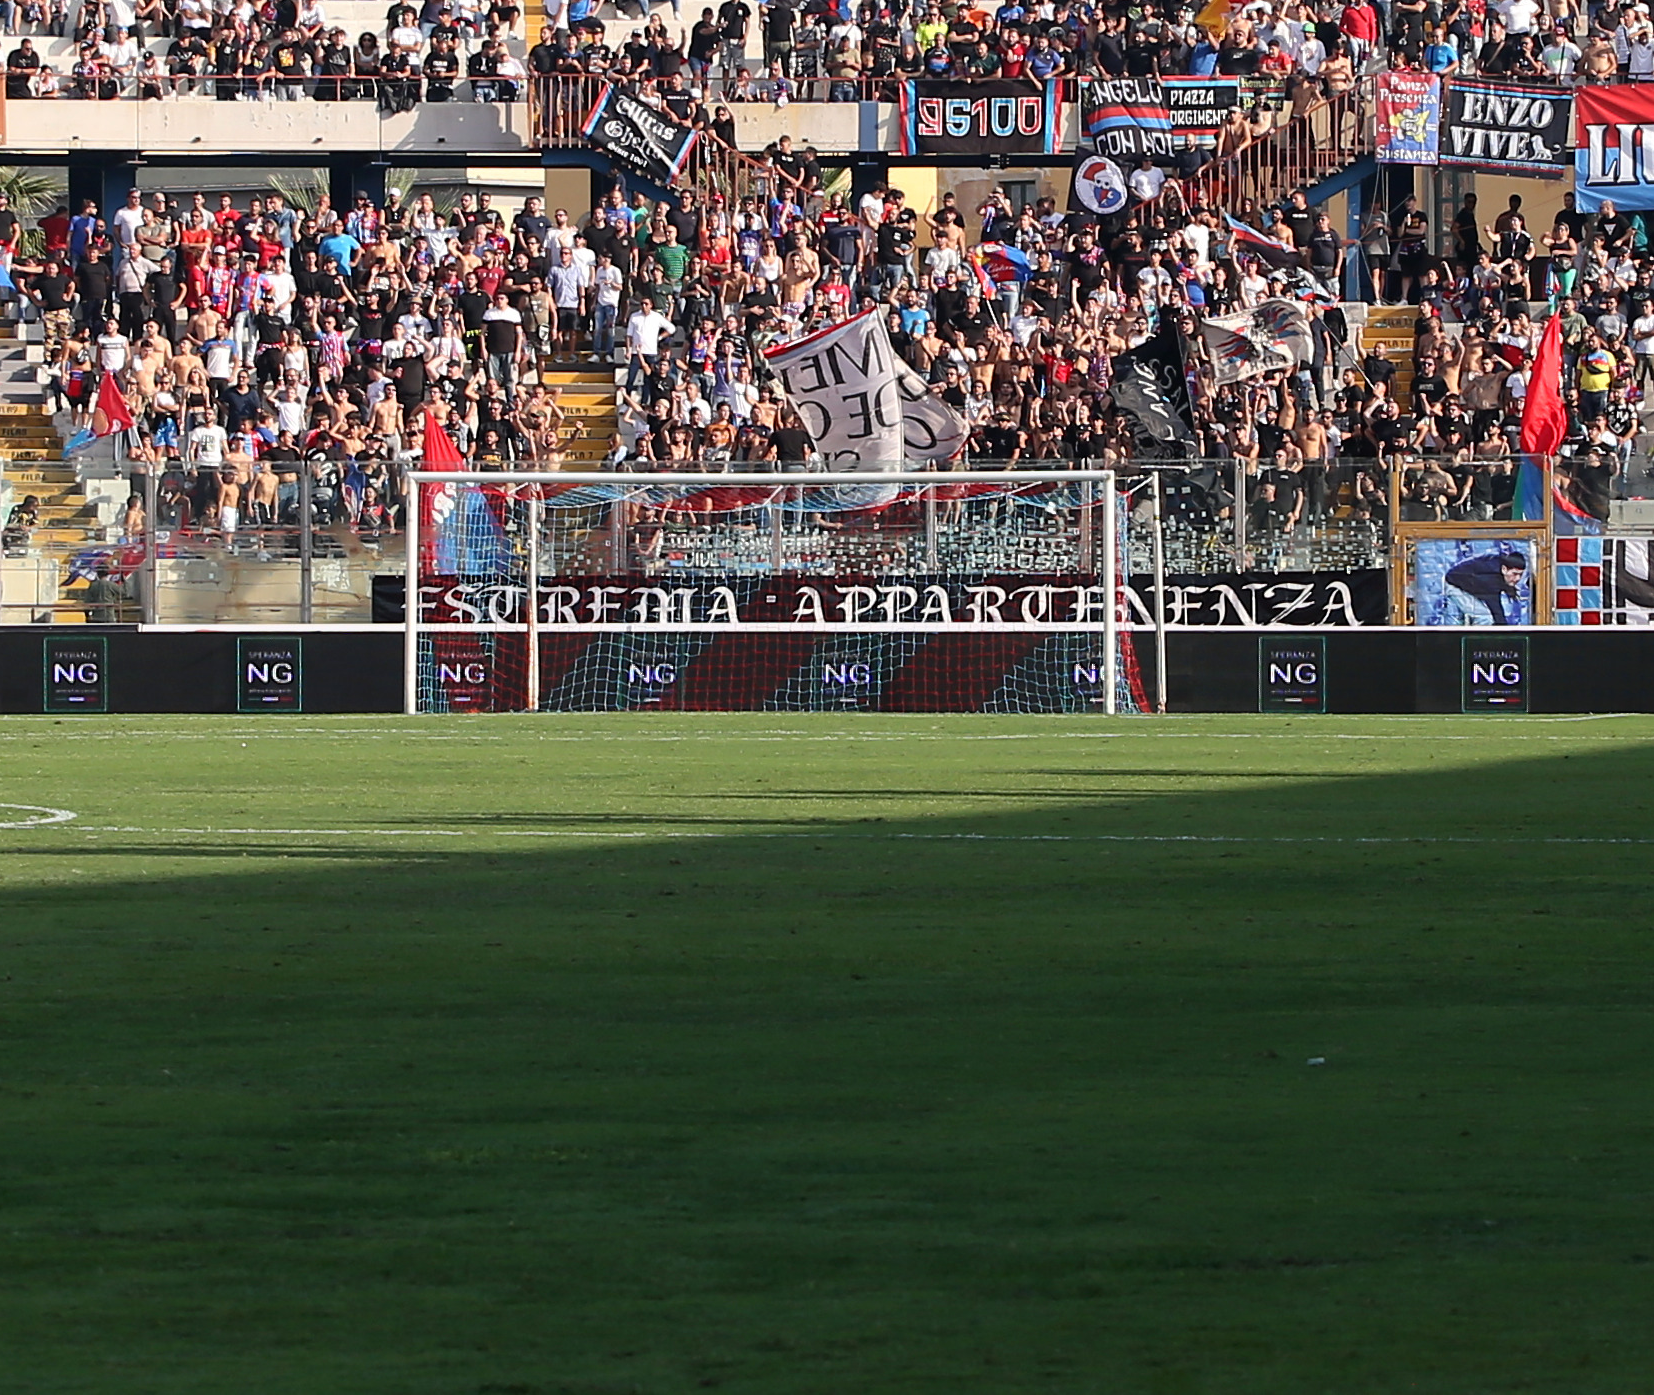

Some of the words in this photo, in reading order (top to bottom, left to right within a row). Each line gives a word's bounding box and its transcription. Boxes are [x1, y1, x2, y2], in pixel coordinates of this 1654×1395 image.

[1390, 76, 1431, 92] Panza
[1170, 90, 1215, 106] PIAZZA
[1380, 88, 1438, 104] Presenza
[918, 96, 1042, 137] 95100
[1168, 109, 1228, 126] ORGIMENT
[1460, 91, 1555, 129] ENZO
[1096, 129, 1137, 156] CON
[1376, 145, 1437, 161] Sustanza
[1450, 125, 1532, 161] VIVE
[401, 582, 741, 624] ESTREMA
[53, 663, 99, 684] NG
[247, 663, 293, 684] NG
[439, 663, 486, 684] NG
[628, 663, 676, 684] NG
[824, 663, 871, 684] NG
[1269, 663, 1317, 684] NG
[1473, 663, 1521, 684] NG
